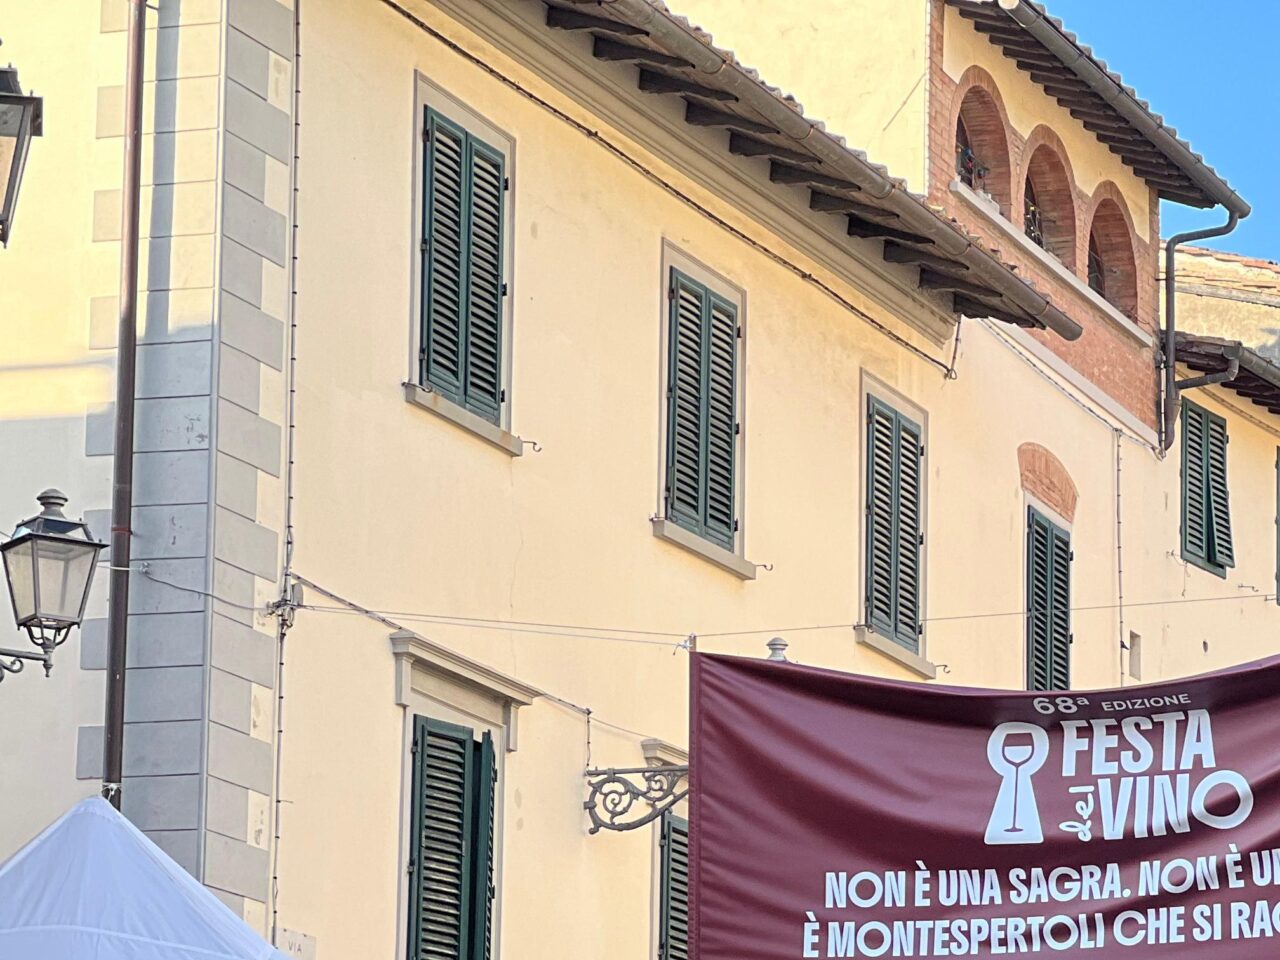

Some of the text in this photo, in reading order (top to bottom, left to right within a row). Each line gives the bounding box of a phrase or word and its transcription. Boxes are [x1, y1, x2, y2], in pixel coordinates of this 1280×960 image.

[1101, 693, 1192, 712] EDIZIONE
[1059, 708, 1216, 777] FESTA
[1058, 785, 1095, 842] del
[1097, 769, 1254, 841] VINO
[824, 871, 906, 909] NON
[914, 859, 931, 907] È
[938, 868, 1002, 906] UNA
[1008, 863, 1131, 905] SAGRA.
[1137, 855, 1220, 897] NON
[1225, 843, 1245, 889] È
[802, 911, 820, 958] È
[826, 912, 1105, 958] MONTESPERTOLI
[1113, 905, 1185, 946] CHE
[1192, 902, 1222, 942] SI
